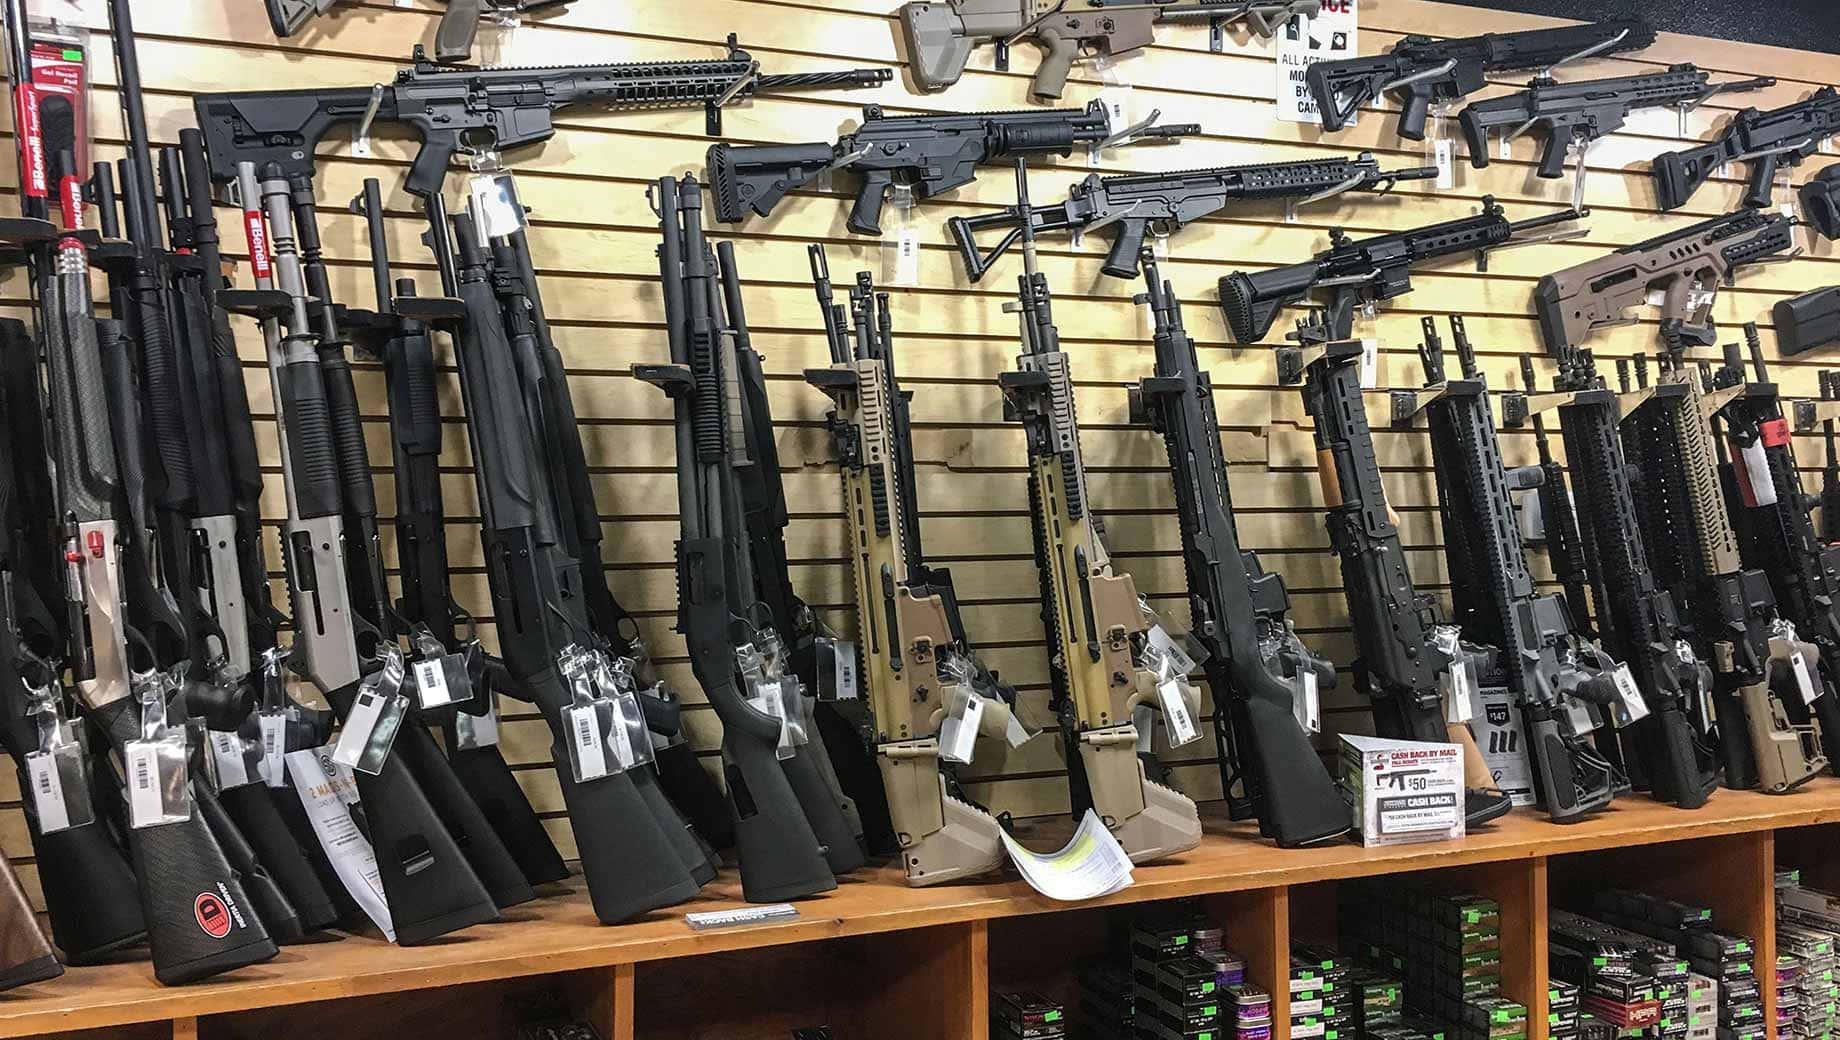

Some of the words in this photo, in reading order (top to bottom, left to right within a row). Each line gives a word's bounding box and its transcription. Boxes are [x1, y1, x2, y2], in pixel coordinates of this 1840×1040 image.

[1282, 53, 1299, 65] ALL
[1290, 70, 1306, 82] MO
[1296, 86, 1308, 98] BY
[1298, 101, 1319, 114] CAM
[29, 136, 45, 182] Benelli
[251, 227, 269, 270] Benelli
[1391, 752, 1408, 760] CASH
[1410, 751, 1427, 759] BACK
[1429, 750, 1438, 758] BY
[1439, 749, 1457, 757] MAIL
[1408, 777, 1426, 790] $50
[1407, 798, 1428, 807] CASH
